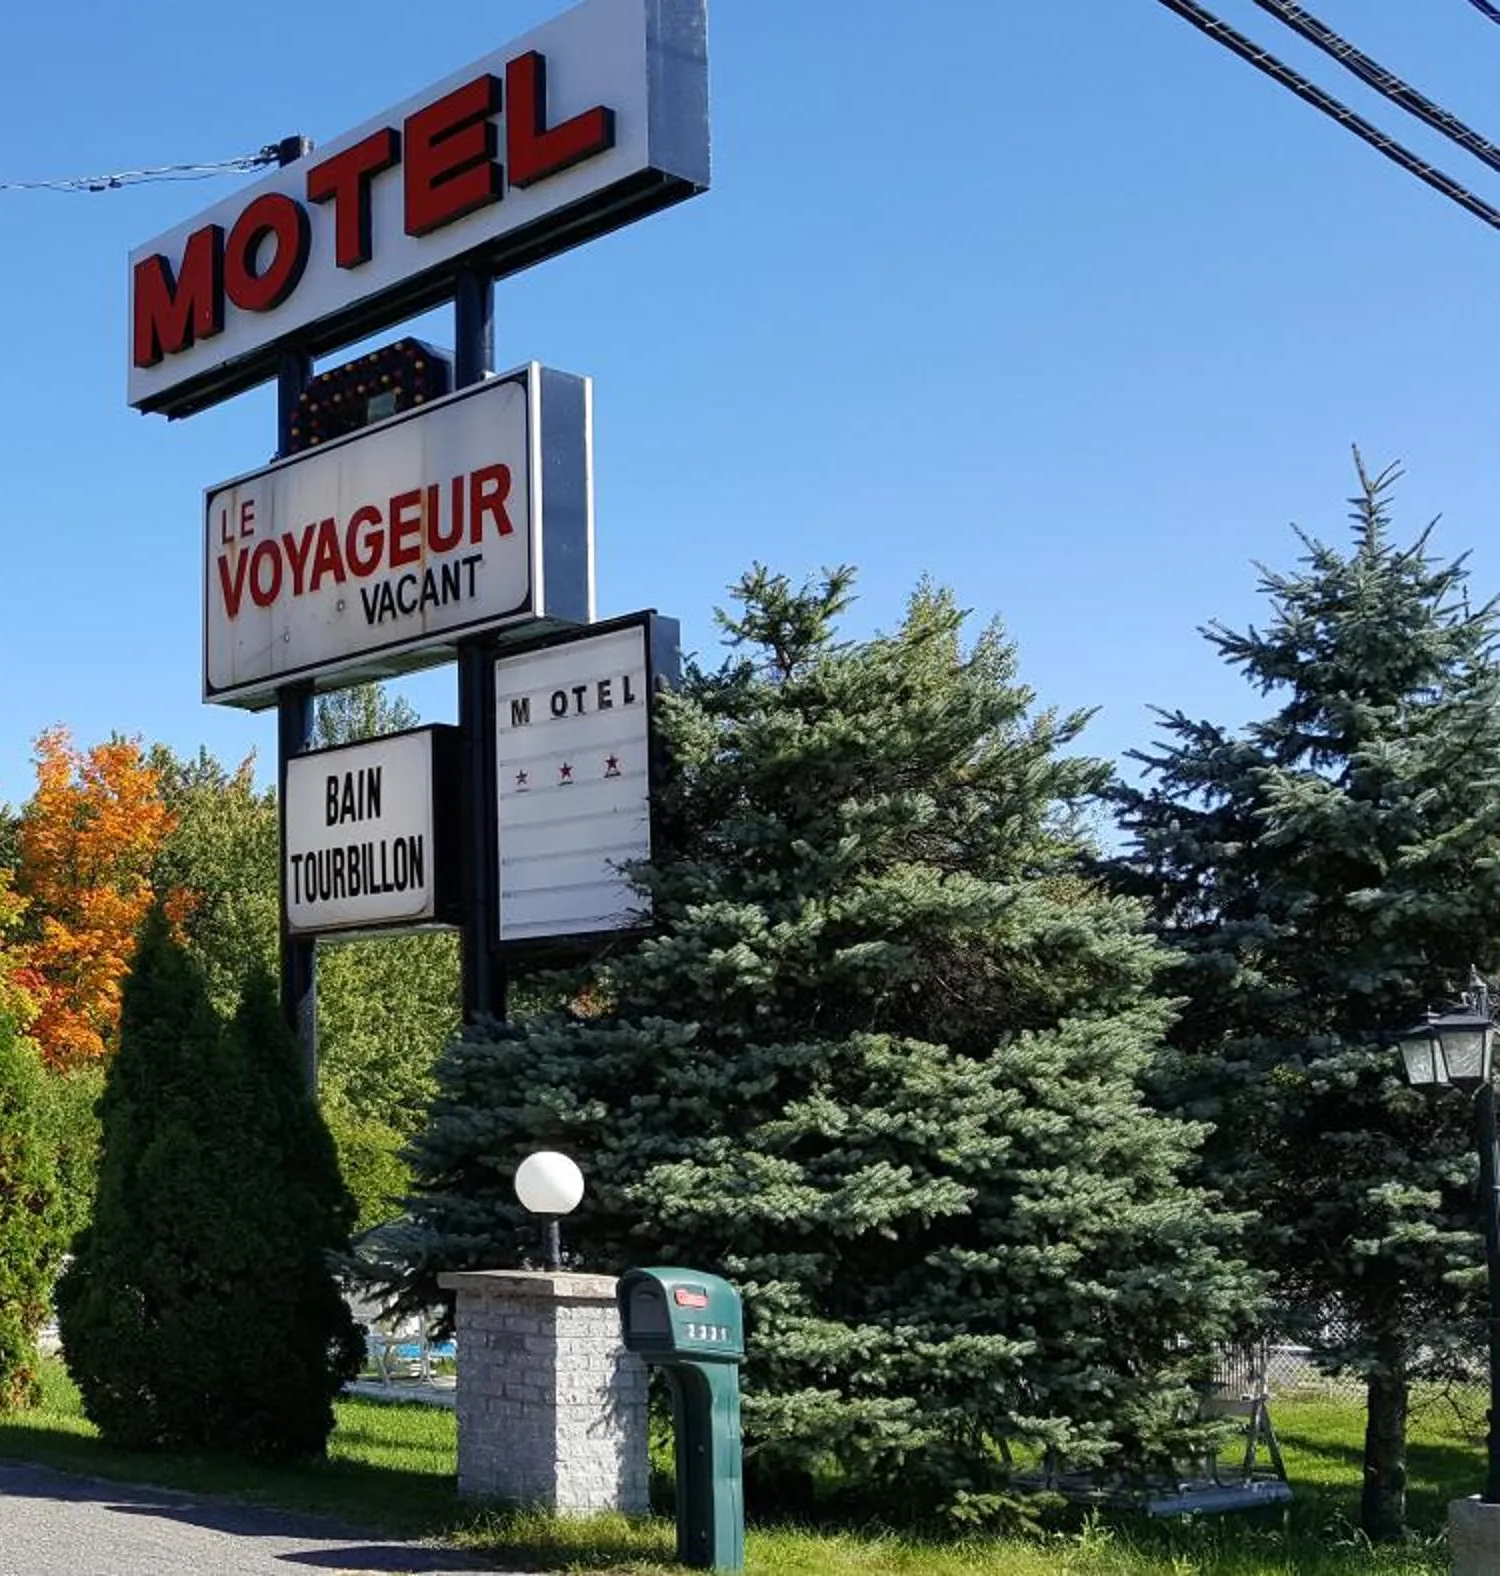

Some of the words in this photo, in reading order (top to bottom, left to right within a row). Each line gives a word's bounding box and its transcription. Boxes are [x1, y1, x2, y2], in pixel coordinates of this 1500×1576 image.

[133, 49, 615, 368] MOTEL
[217, 463, 513, 621] VOYAGEUR
[222, 499, 255, 545] LE
[361, 554, 482, 625] VACANT
[326, 766, 383, 826] BAIN
[291, 834, 424, 905] TOURBILLON
